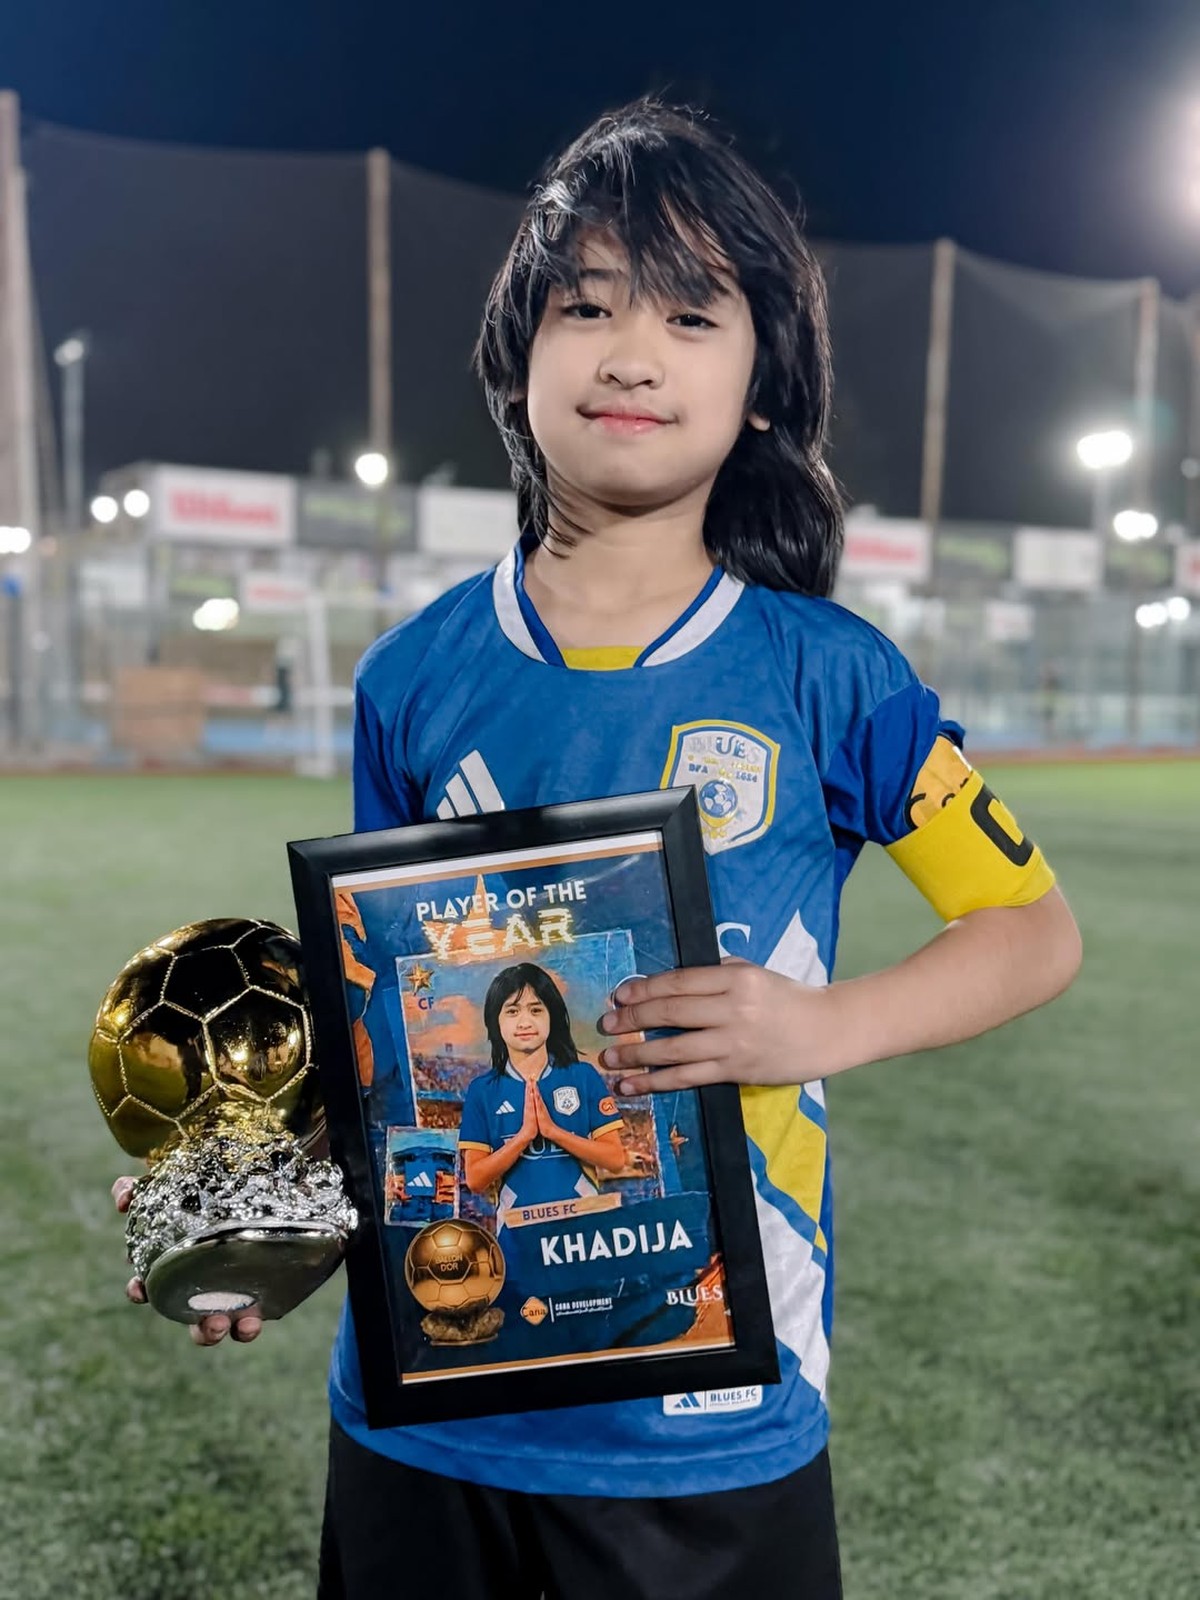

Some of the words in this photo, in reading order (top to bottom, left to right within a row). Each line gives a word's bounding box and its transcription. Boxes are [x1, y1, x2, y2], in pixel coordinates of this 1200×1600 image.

[416, 892, 499, 922] PLAYER
[506, 886, 537, 909] OF
[543, 880, 587, 904] THE
[422, 907, 576, 960] YEAR
[418, 996, 434, 1011] CF
[522, 1207, 559, 1221] BLUES
[563, 1203, 577, 1215] FC
[540, 1219, 693, 1266] KHADIJA
[571, 1297, 612, 1310] DEVELOPMENT
[666, 1284, 723, 1307] BLUES
[710, 1391, 742, 1402] BLUES
[745, 1387, 757, 1398] FC
